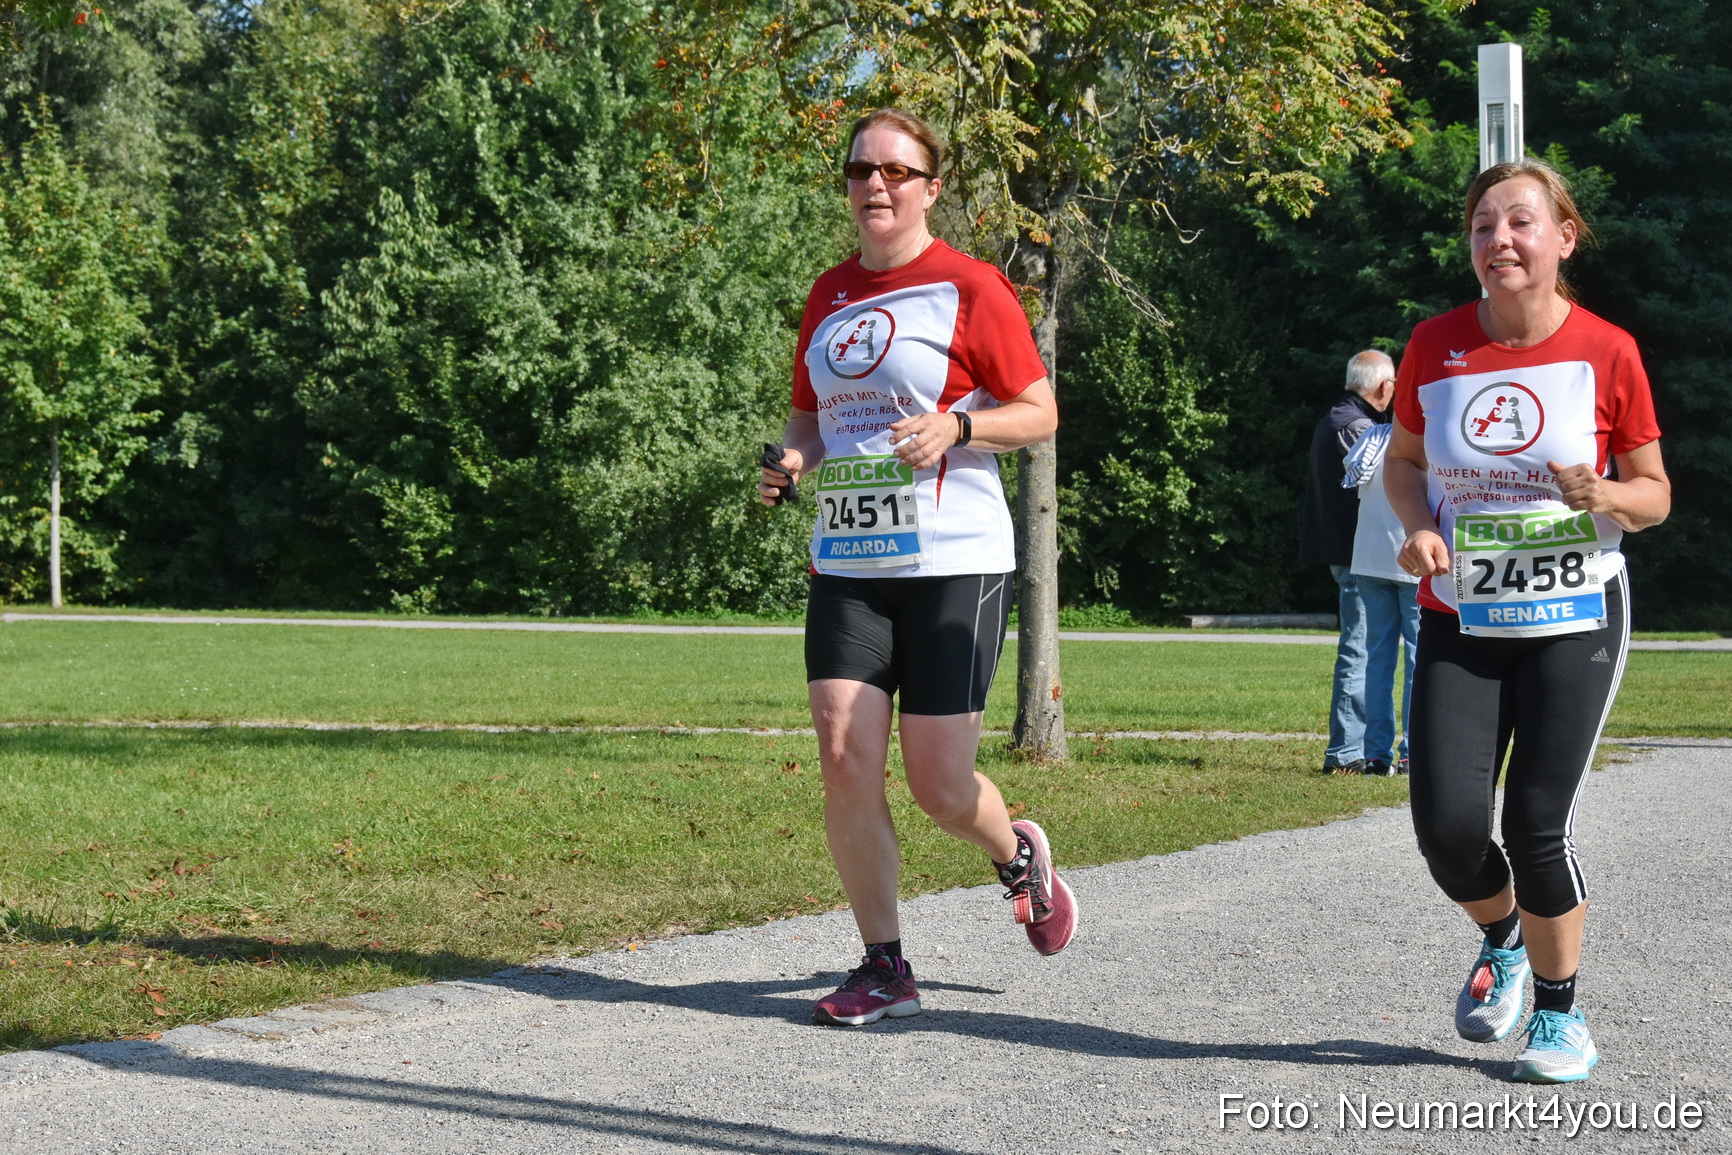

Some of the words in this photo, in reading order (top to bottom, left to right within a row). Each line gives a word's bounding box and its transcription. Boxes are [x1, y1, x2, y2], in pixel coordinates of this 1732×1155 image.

[1443, 359, 1468, 367] erima
[857, 391, 878, 402] MIT
[823, 460, 900, 484] BOCK
[1489, 469, 1518, 480] MIT
[1448, 491, 1553, 505] Leistungsdiagnostik
[825, 494, 900, 530] 2451
[1468, 514, 1582, 543] BOCK
[830, 539, 899, 556] RICARDA
[1471, 551, 1586, 595] 2458
[1488, 602, 1575, 623] RENATE
